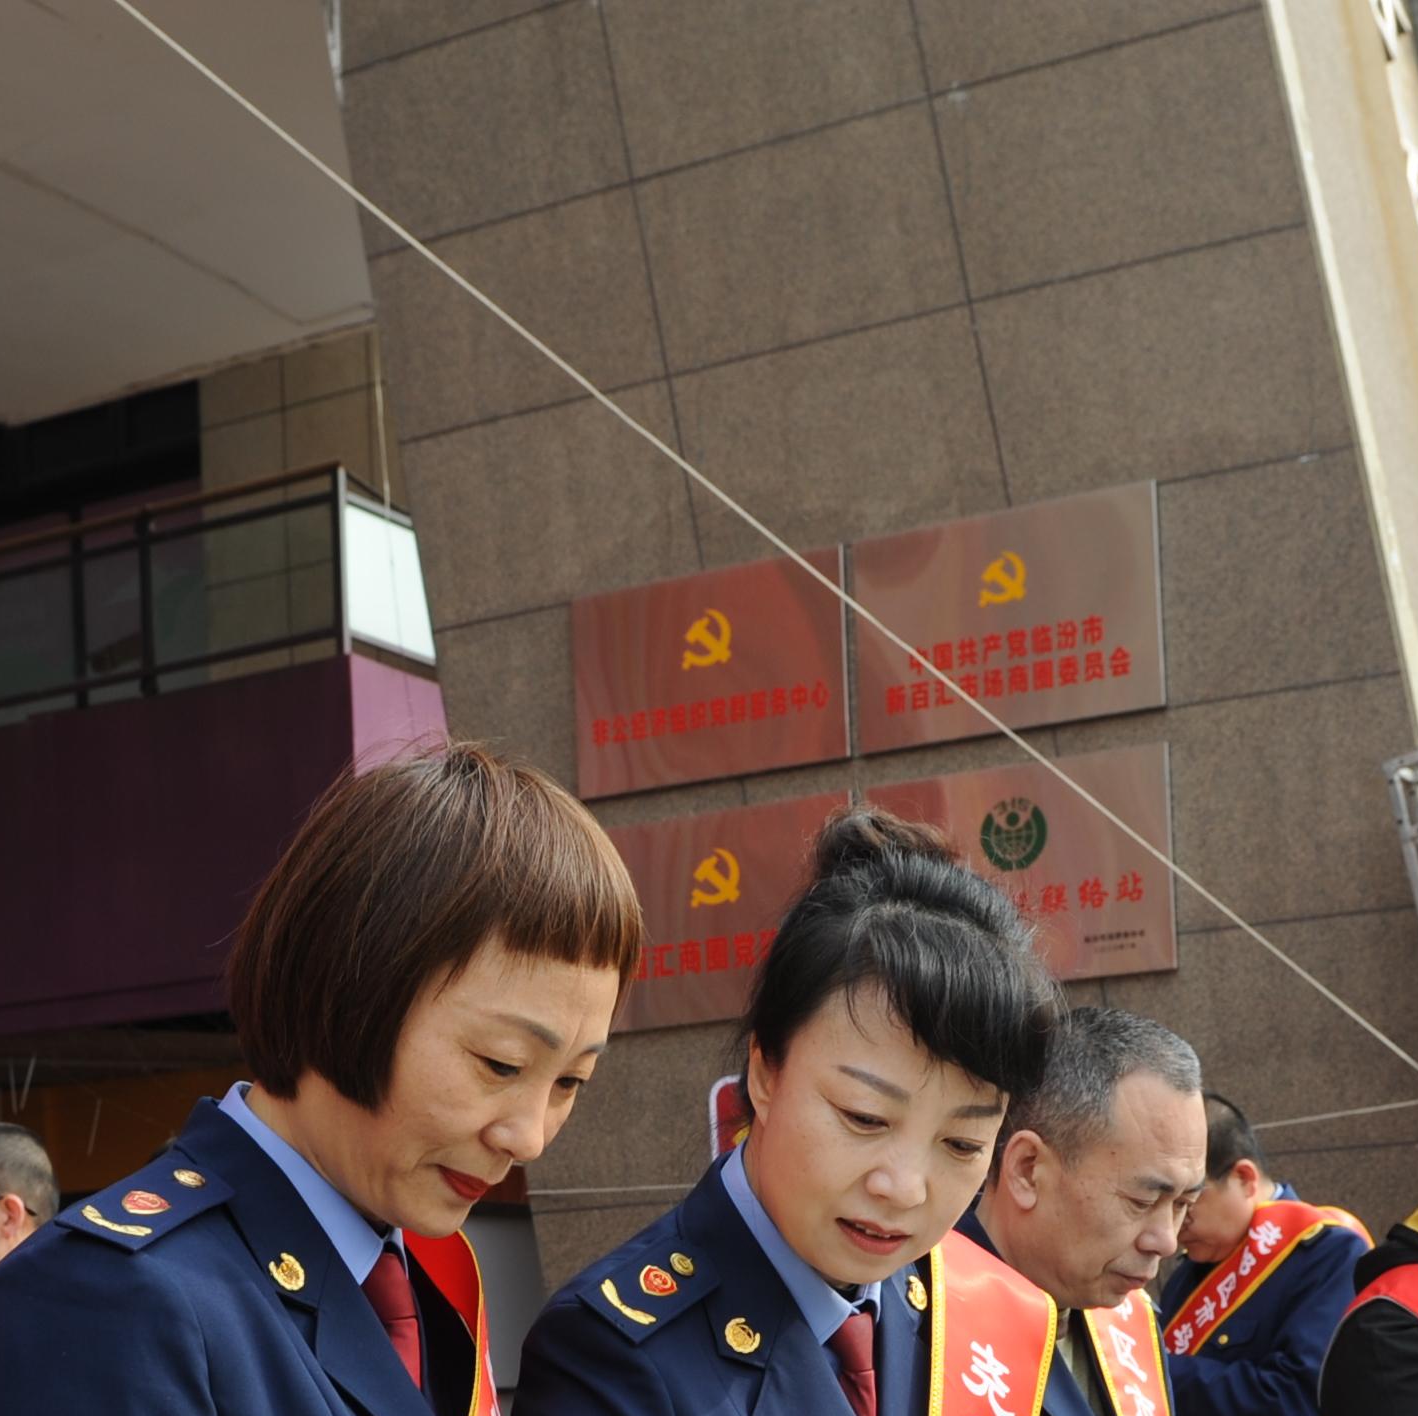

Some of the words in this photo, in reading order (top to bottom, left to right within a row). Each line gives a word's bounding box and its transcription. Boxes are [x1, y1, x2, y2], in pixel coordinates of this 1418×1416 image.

[908, 614, 1105, 676] 中国共产党临汾市
[885, 646, 1130, 717] 新百汇市场商圈委员会
